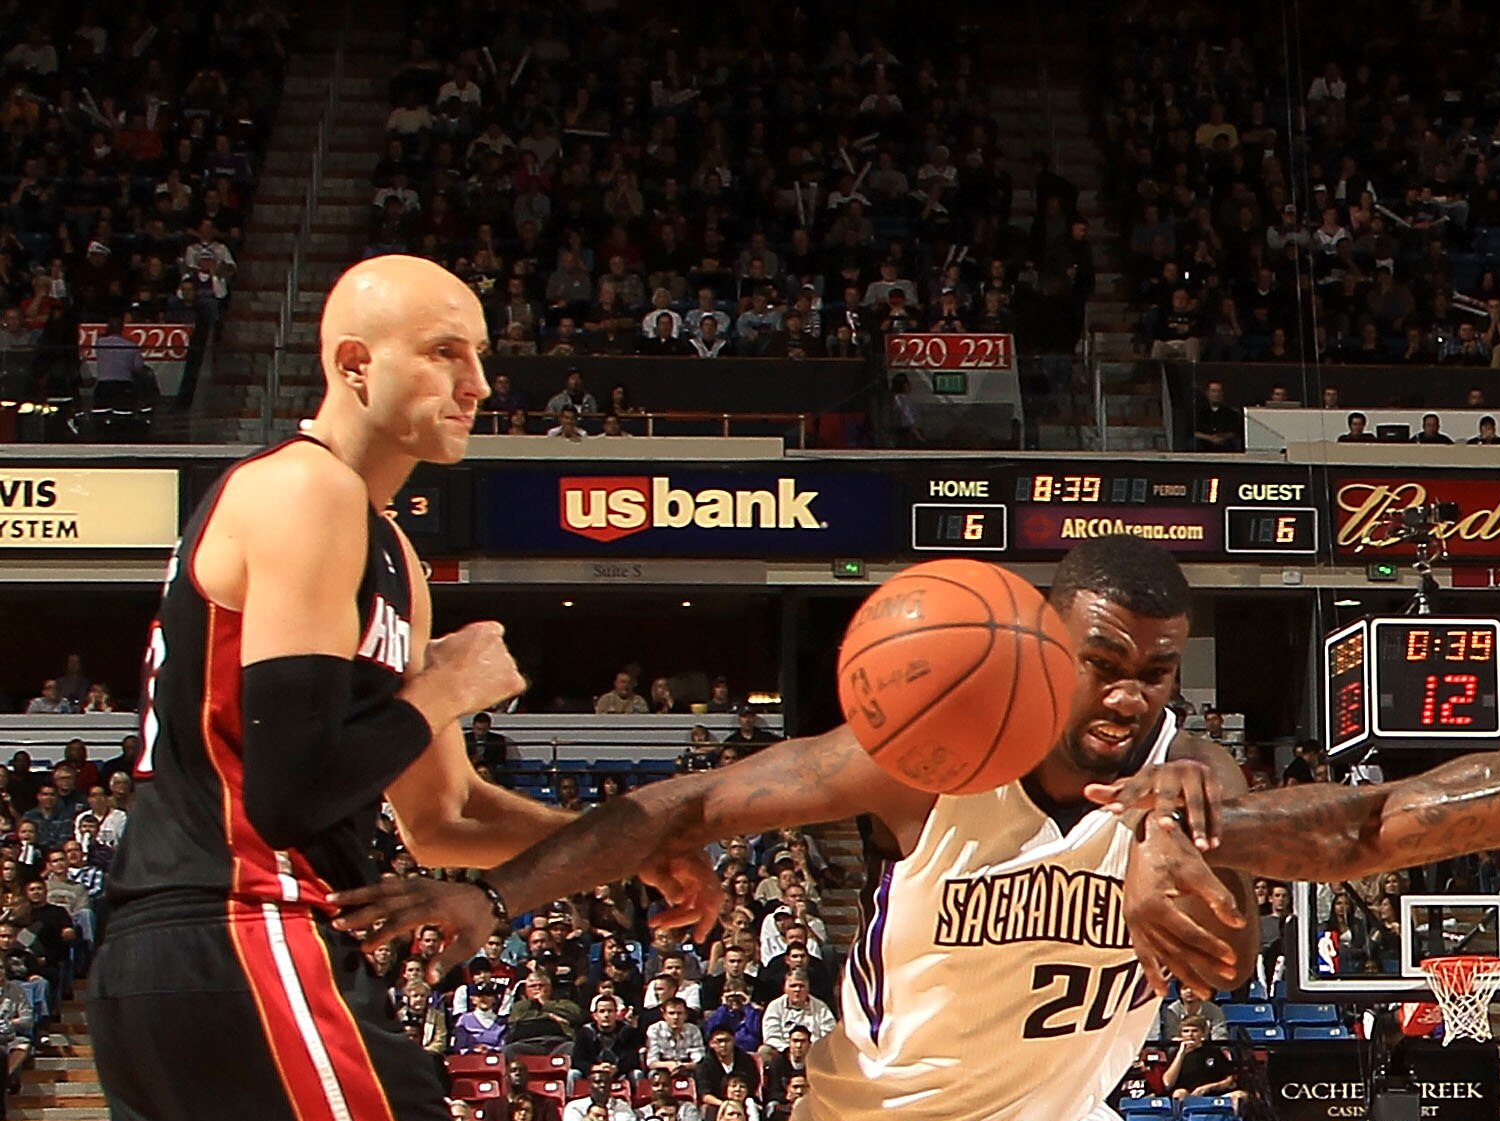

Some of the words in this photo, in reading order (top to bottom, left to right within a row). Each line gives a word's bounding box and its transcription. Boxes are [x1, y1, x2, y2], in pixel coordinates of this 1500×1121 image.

[889, 338, 947, 367] 220
[959, 339, 1008, 368] 221
[930, 481, 989, 498] HOME
[1033, 476, 1100, 502] 8:39
[1209, 478, 1218, 503] 1
[1238, 484, 1305, 501] GUEST
[411, 496, 428, 515] 3
[964, 514, 985, 540] 6
[1276, 517, 1297, 543] 6
[1421, 674, 1479, 725] 12
[934, 864, 1135, 949] SACRAMEN
[1022, 960, 1148, 1040] 20
[1281, 1082, 1364, 1100] CACHE
[1413, 1082, 1484, 1099] REEK
